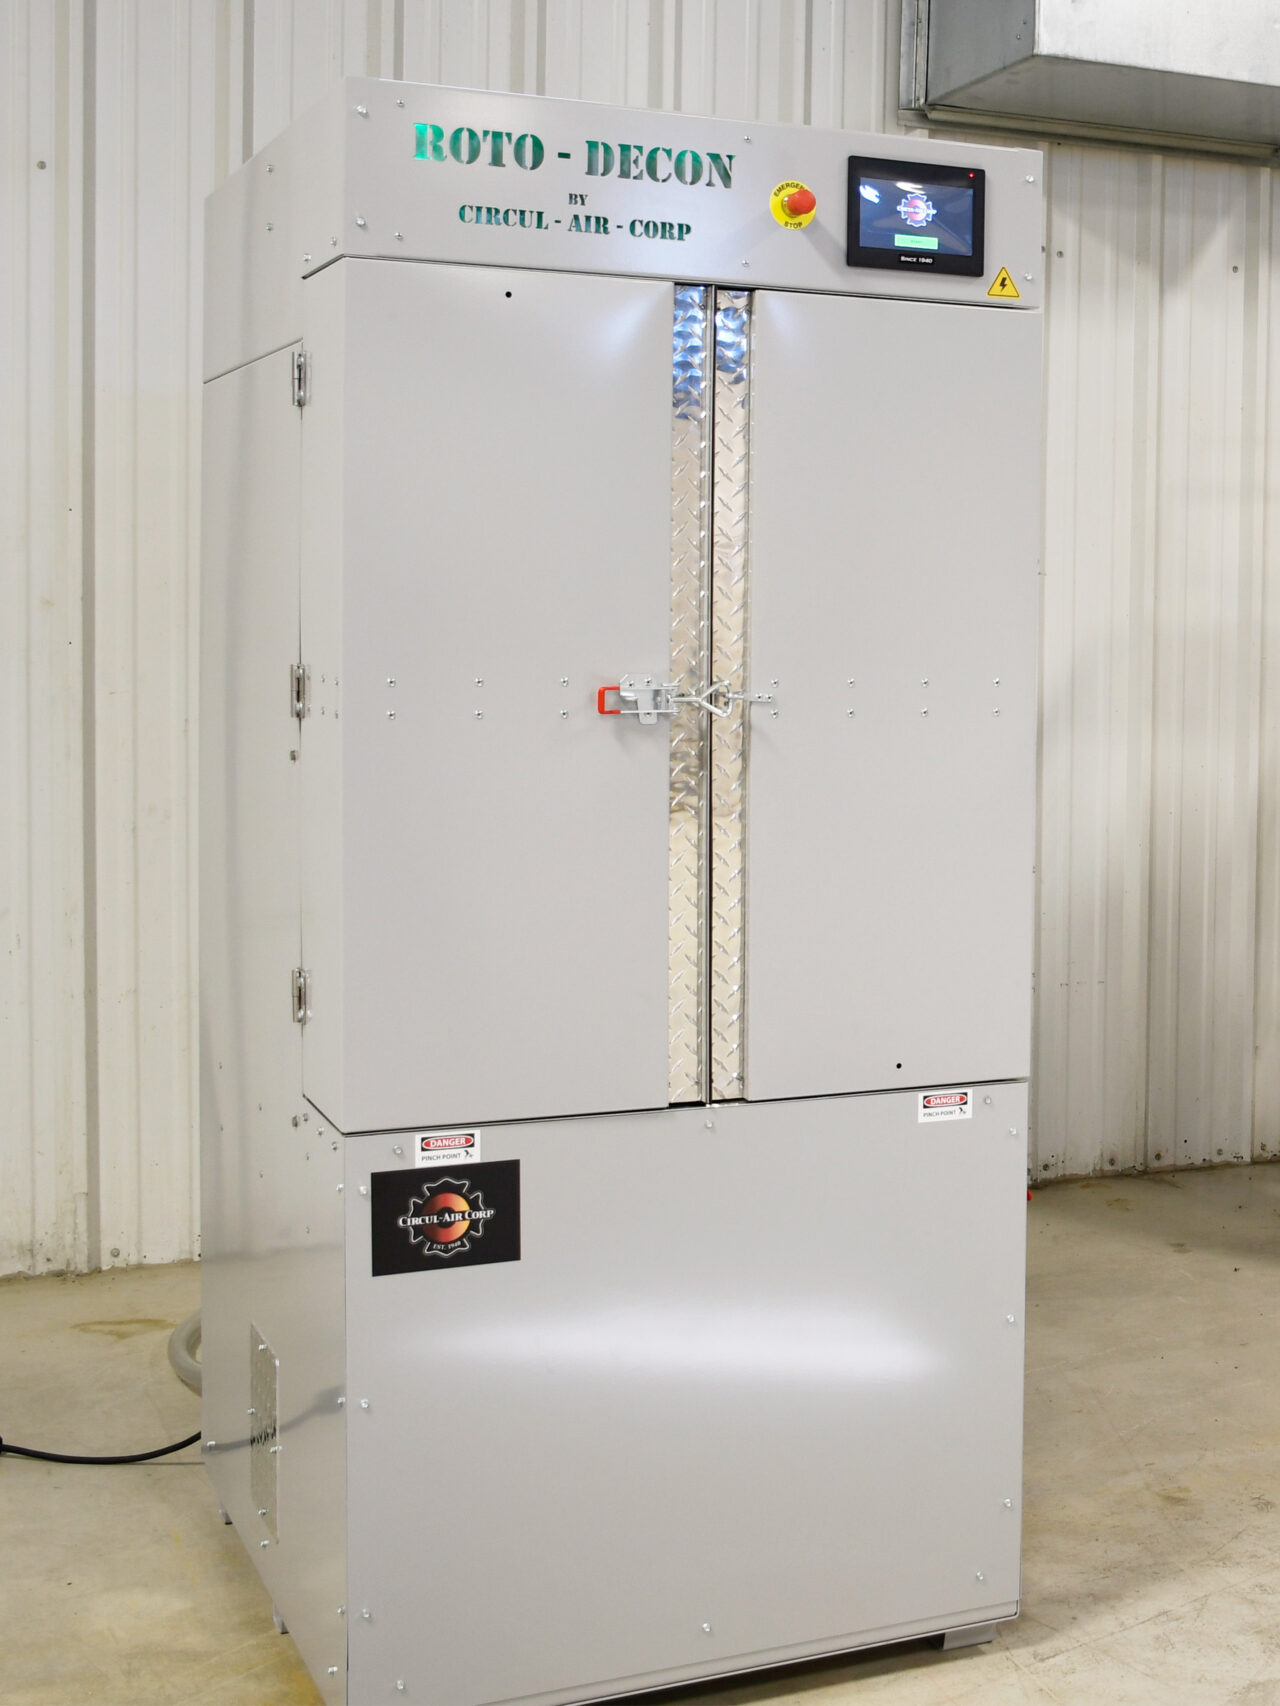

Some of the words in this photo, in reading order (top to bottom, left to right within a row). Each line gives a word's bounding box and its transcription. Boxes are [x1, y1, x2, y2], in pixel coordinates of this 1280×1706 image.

[413, 122, 545, 171] ROTO
[585, 140, 736, 189] DECON
[568, 193, 588, 206] BY
[458, 204, 549, 230] CIRCUL
[567, 213, 611, 236] AIR
[629, 218, 692, 242] CORP
[784, 220, 803, 229] STOP
[930, 1095, 961, 1105] DANGER
[430, 1137, 466, 1147] DANGER
[421, 1154, 441, 1162] PINCH
[442, 1152, 461, 1160] POINT
